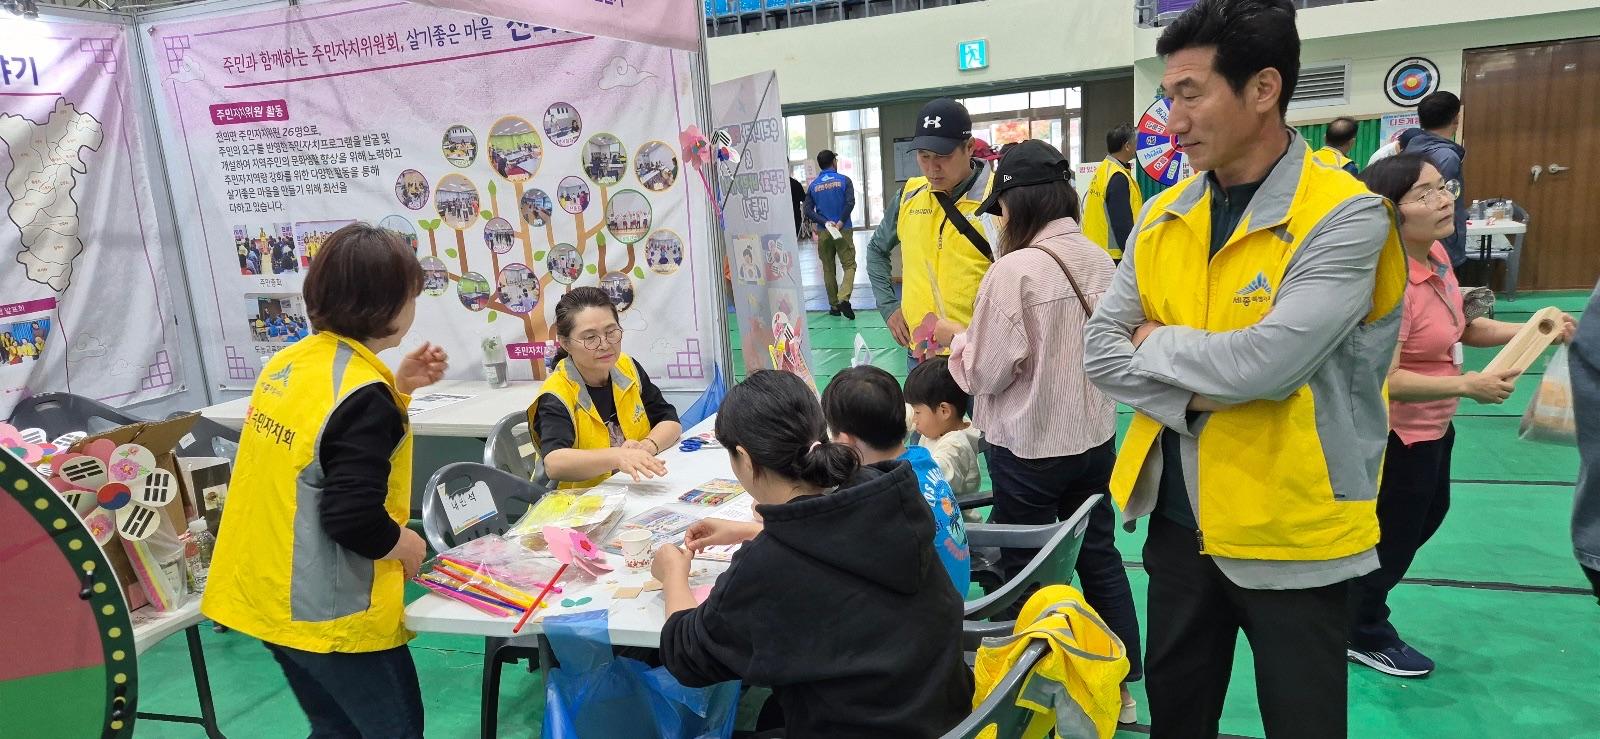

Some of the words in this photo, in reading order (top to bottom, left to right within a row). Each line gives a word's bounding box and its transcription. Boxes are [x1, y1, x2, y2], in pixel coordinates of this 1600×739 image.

[223, 53, 258, 75] 주민과
[259, 48, 308, 71] 함께하는
[406, 22, 460, 51] 살기좋은
[464, 17, 493, 41] 마을
[266, 104, 284, 118] 활동
[219, 144, 241, 157] 주민의
[242, 143, 264, 155] 요구를
[362, 133, 380, 147] 발굴
[380, 131, 391, 145] 및
[221, 159, 251, 172] 개설하여
[252, 155, 289, 169] 지역주민의
[349, 150, 367, 163] 위해
[269, 170, 292, 183] 강화를
[293, 168, 309, 181] 위한
[362, 164, 380, 178] 통해
[226, 187, 256, 200] 살기좋은
[257, 185, 280, 198] 마을을
[281, 183, 304, 197] 만들기
[305, 182, 322, 195] 위해
[323, 181, 348, 194] 최선을
[229, 202, 252, 214] 다하고
